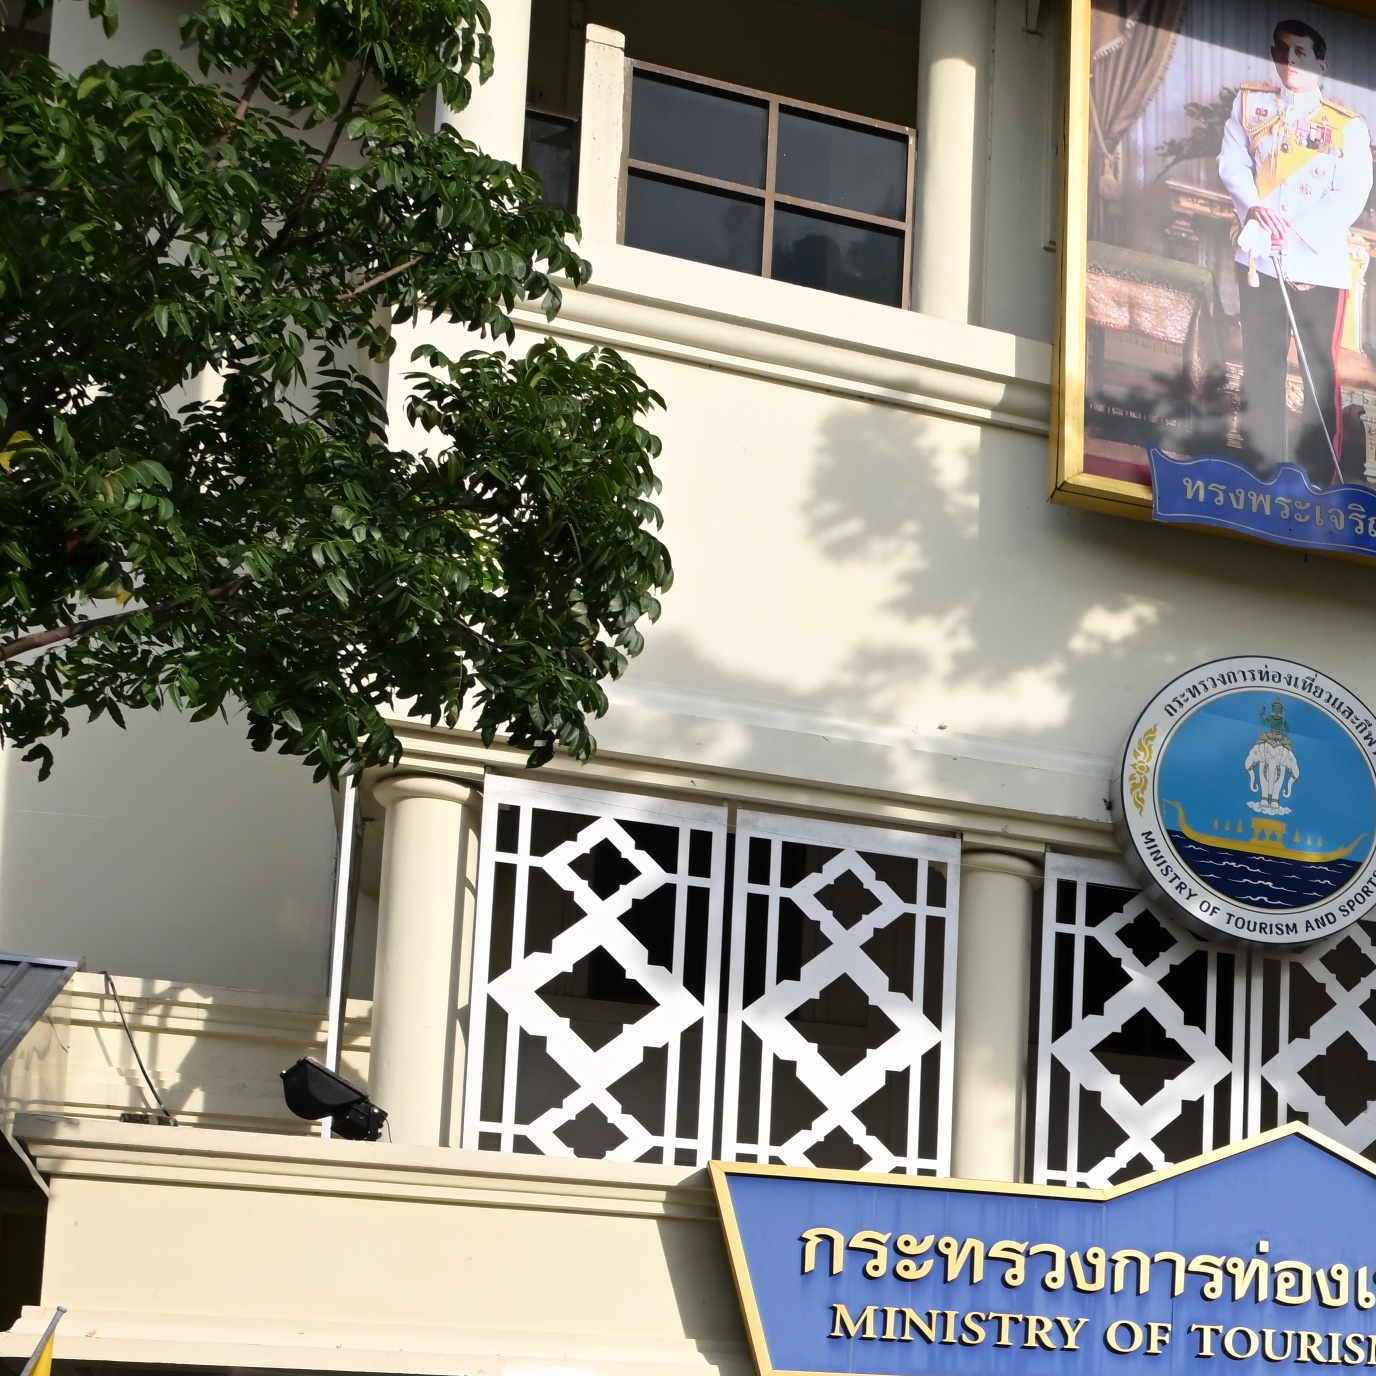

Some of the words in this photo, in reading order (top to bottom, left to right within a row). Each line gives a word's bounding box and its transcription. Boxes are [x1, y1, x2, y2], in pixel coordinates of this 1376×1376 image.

[1140, 829, 1199, 902] MINISTRY
[1198, 899, 1221, 918] OF
[1225, 911, 1299, 936] TOURISM
[1304, 911, 1337, 933] AND
[830, 1302, 1090, 1351] MINISTRY
[1104, 1318, 1173, 1356] OF
